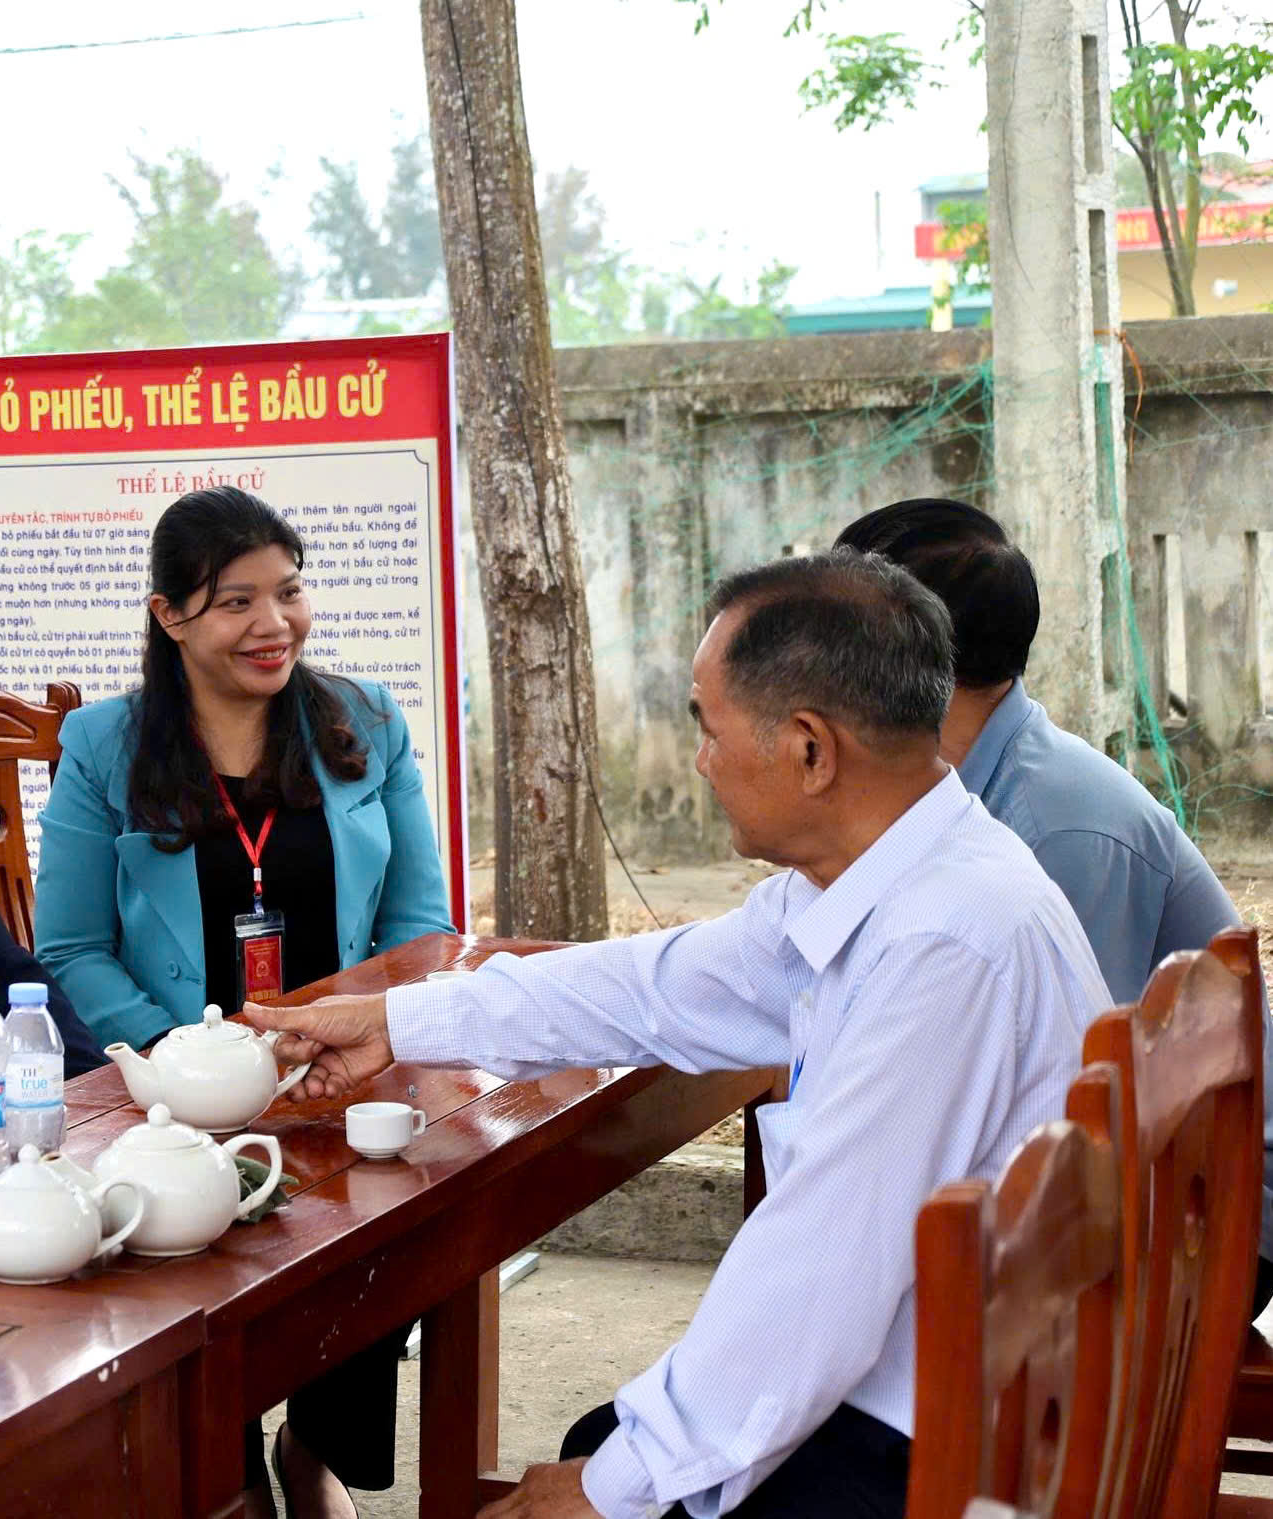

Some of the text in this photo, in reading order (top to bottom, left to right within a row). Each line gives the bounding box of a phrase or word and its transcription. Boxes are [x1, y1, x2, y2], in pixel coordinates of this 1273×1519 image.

[30, 374, 134, 433] PHIẾU,
[142, 365, 202, 426] THỂ
[212, 373, 249, 433] LỆ
[260, 363, 326, 421] BẦU
[337, 359, 387, 418] CỬ
[117, 468, 156, 495] THỂ
[162, 471, 187, 498] LỆ
[238, 466, 265, 490] CỬ
